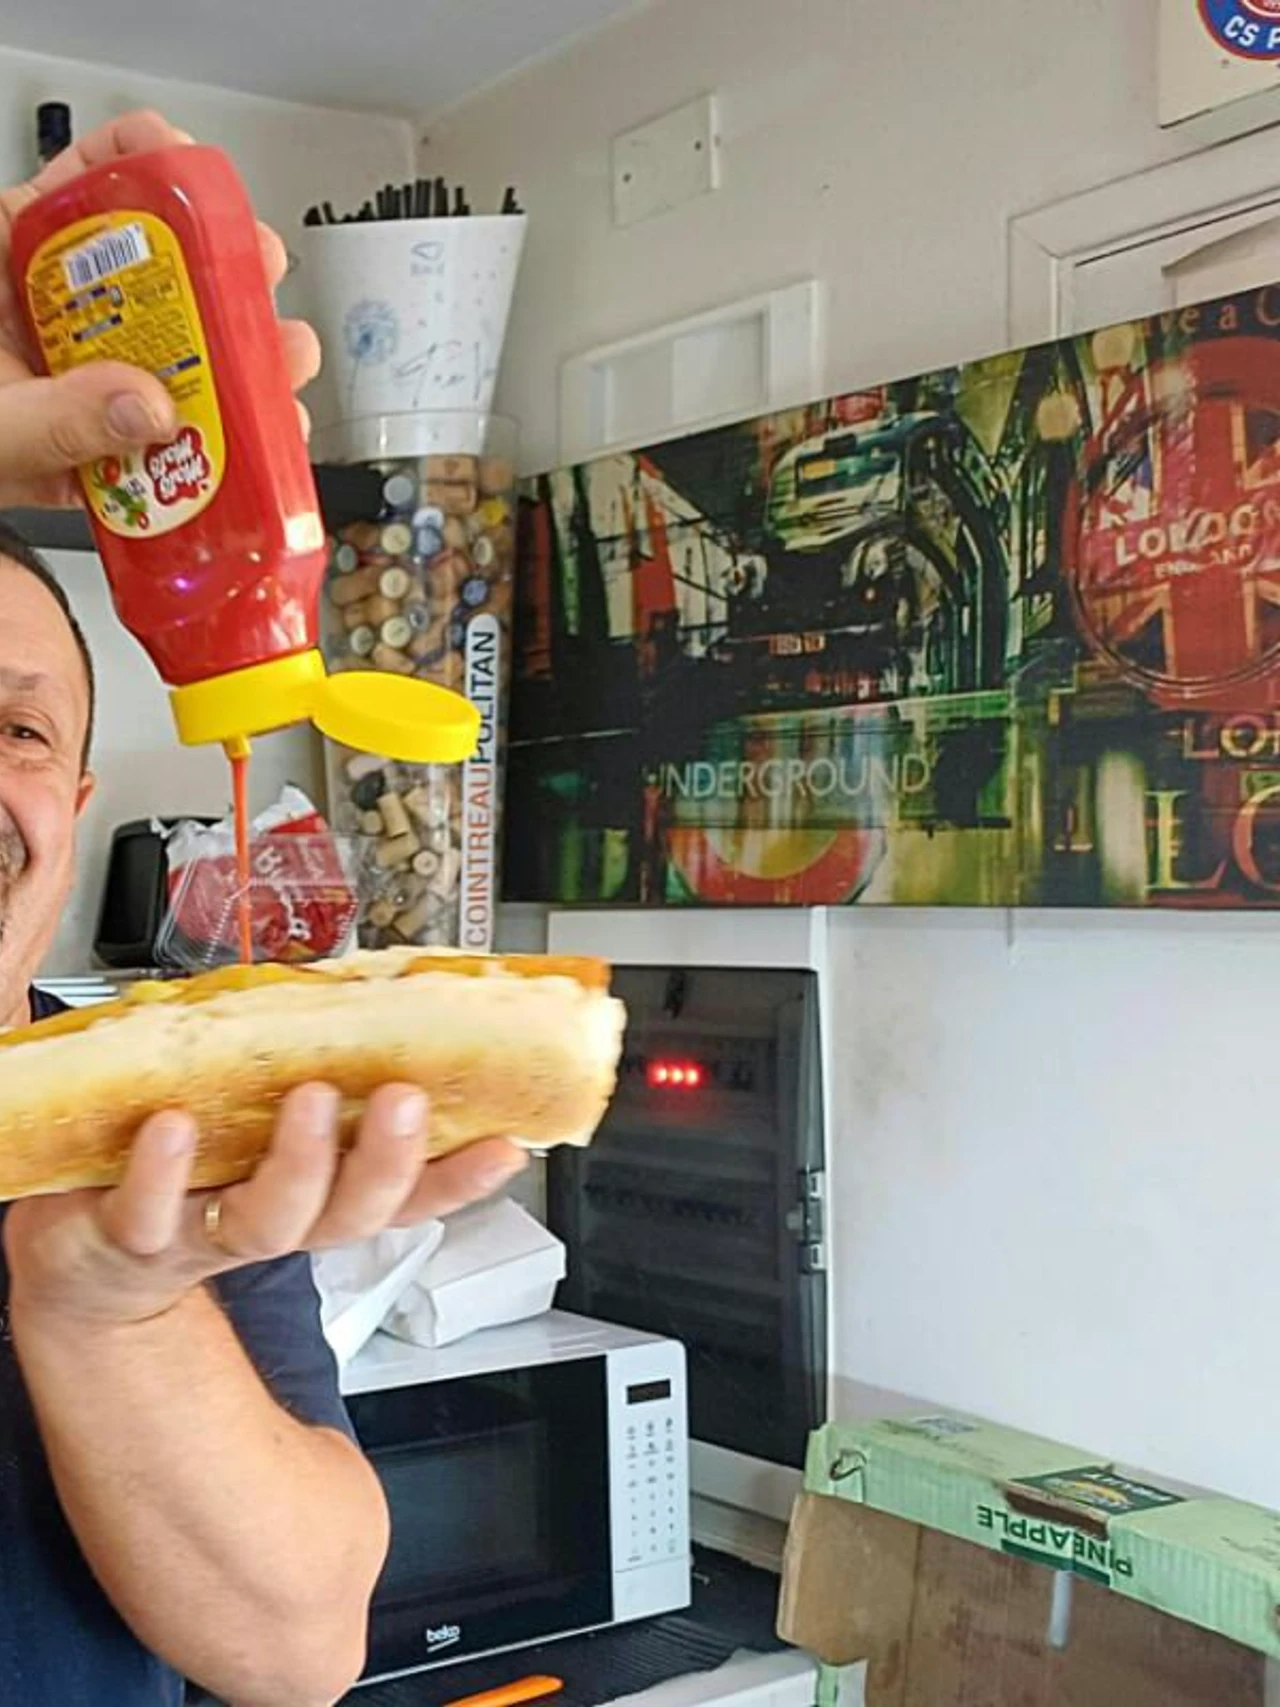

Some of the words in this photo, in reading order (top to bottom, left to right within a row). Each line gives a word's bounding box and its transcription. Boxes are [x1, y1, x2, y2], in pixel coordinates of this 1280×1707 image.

[1224, 15, 1260, 46] CS
[1183, 713, 1280, 760] LO
[977, 1504, 1133, 1578] PINEAPPLE
